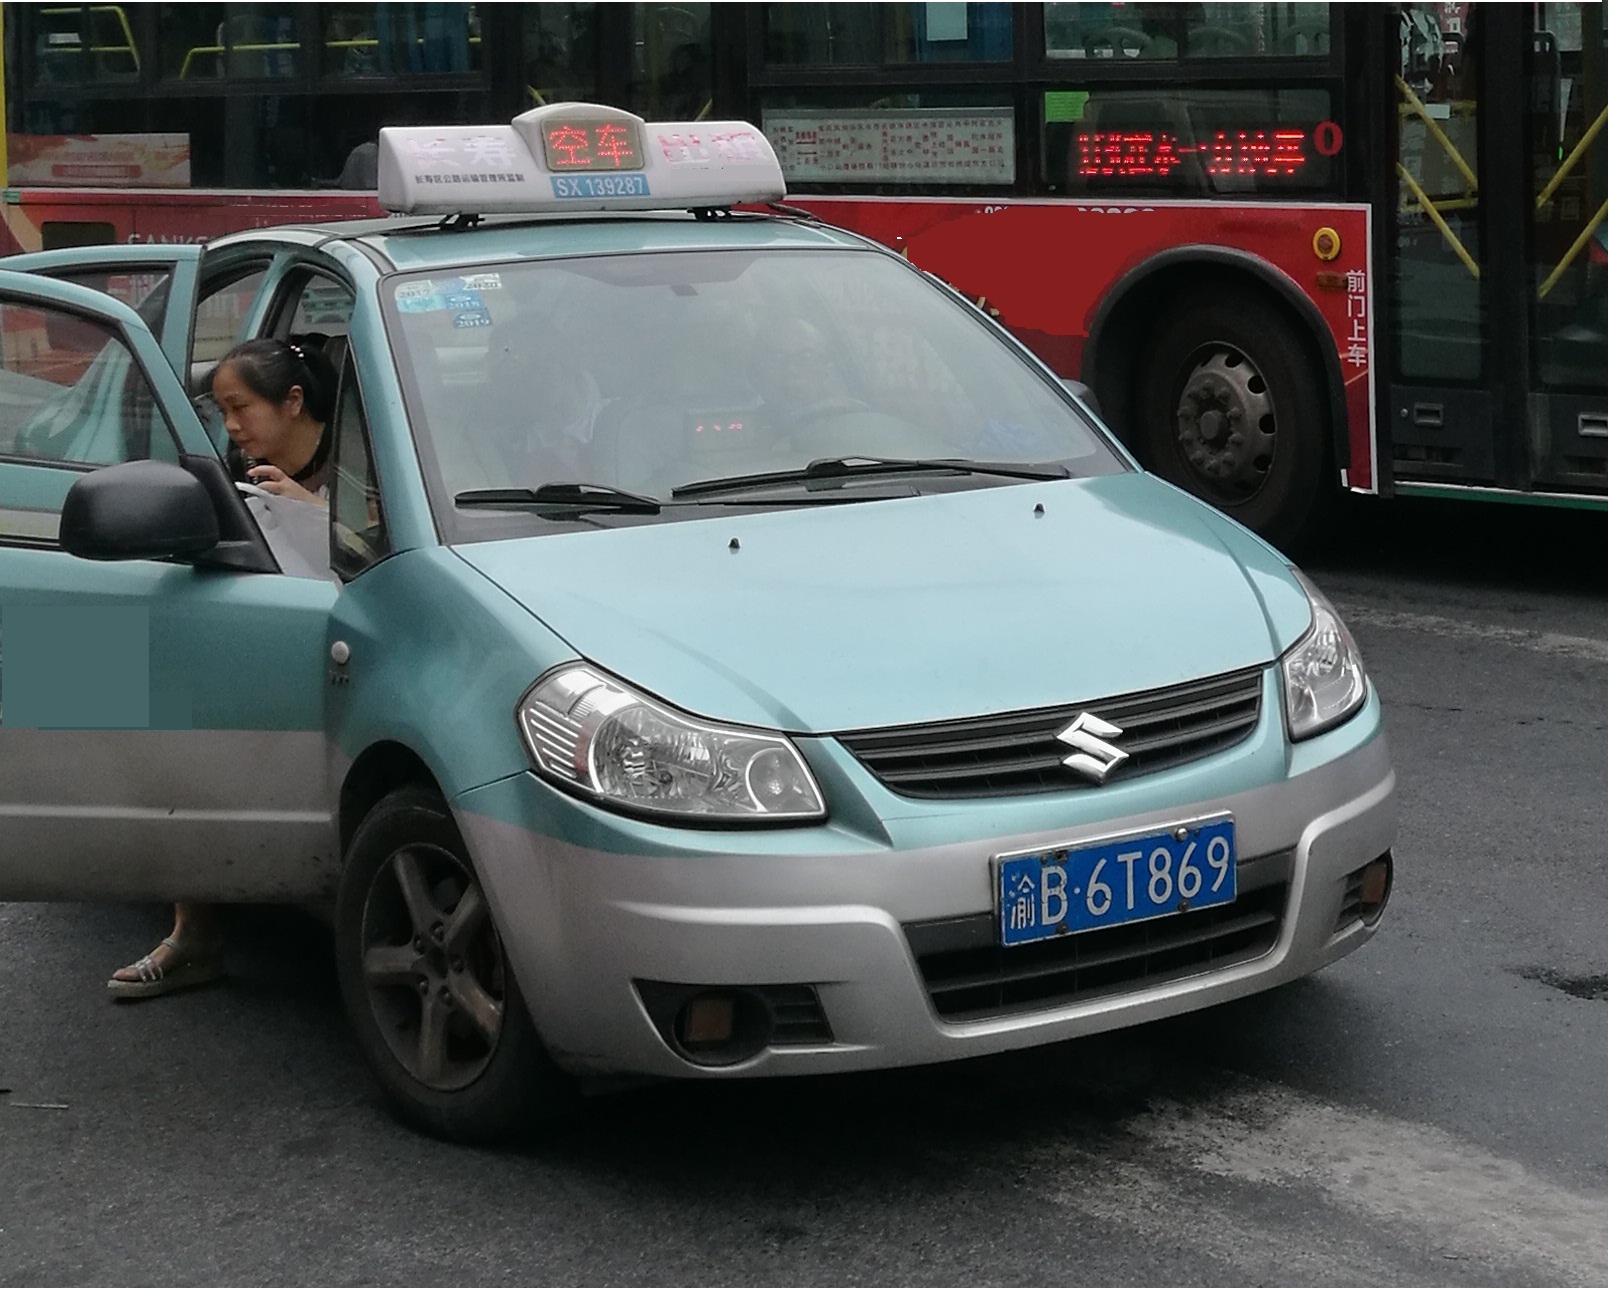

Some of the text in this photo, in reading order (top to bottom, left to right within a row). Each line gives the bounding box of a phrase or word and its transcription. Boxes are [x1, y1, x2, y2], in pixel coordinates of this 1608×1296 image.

[549, 124, 633, 167] 空车
[556, 175, 644, 196] SX 139287
[1346, 269, 1367, 368] 前门上车
